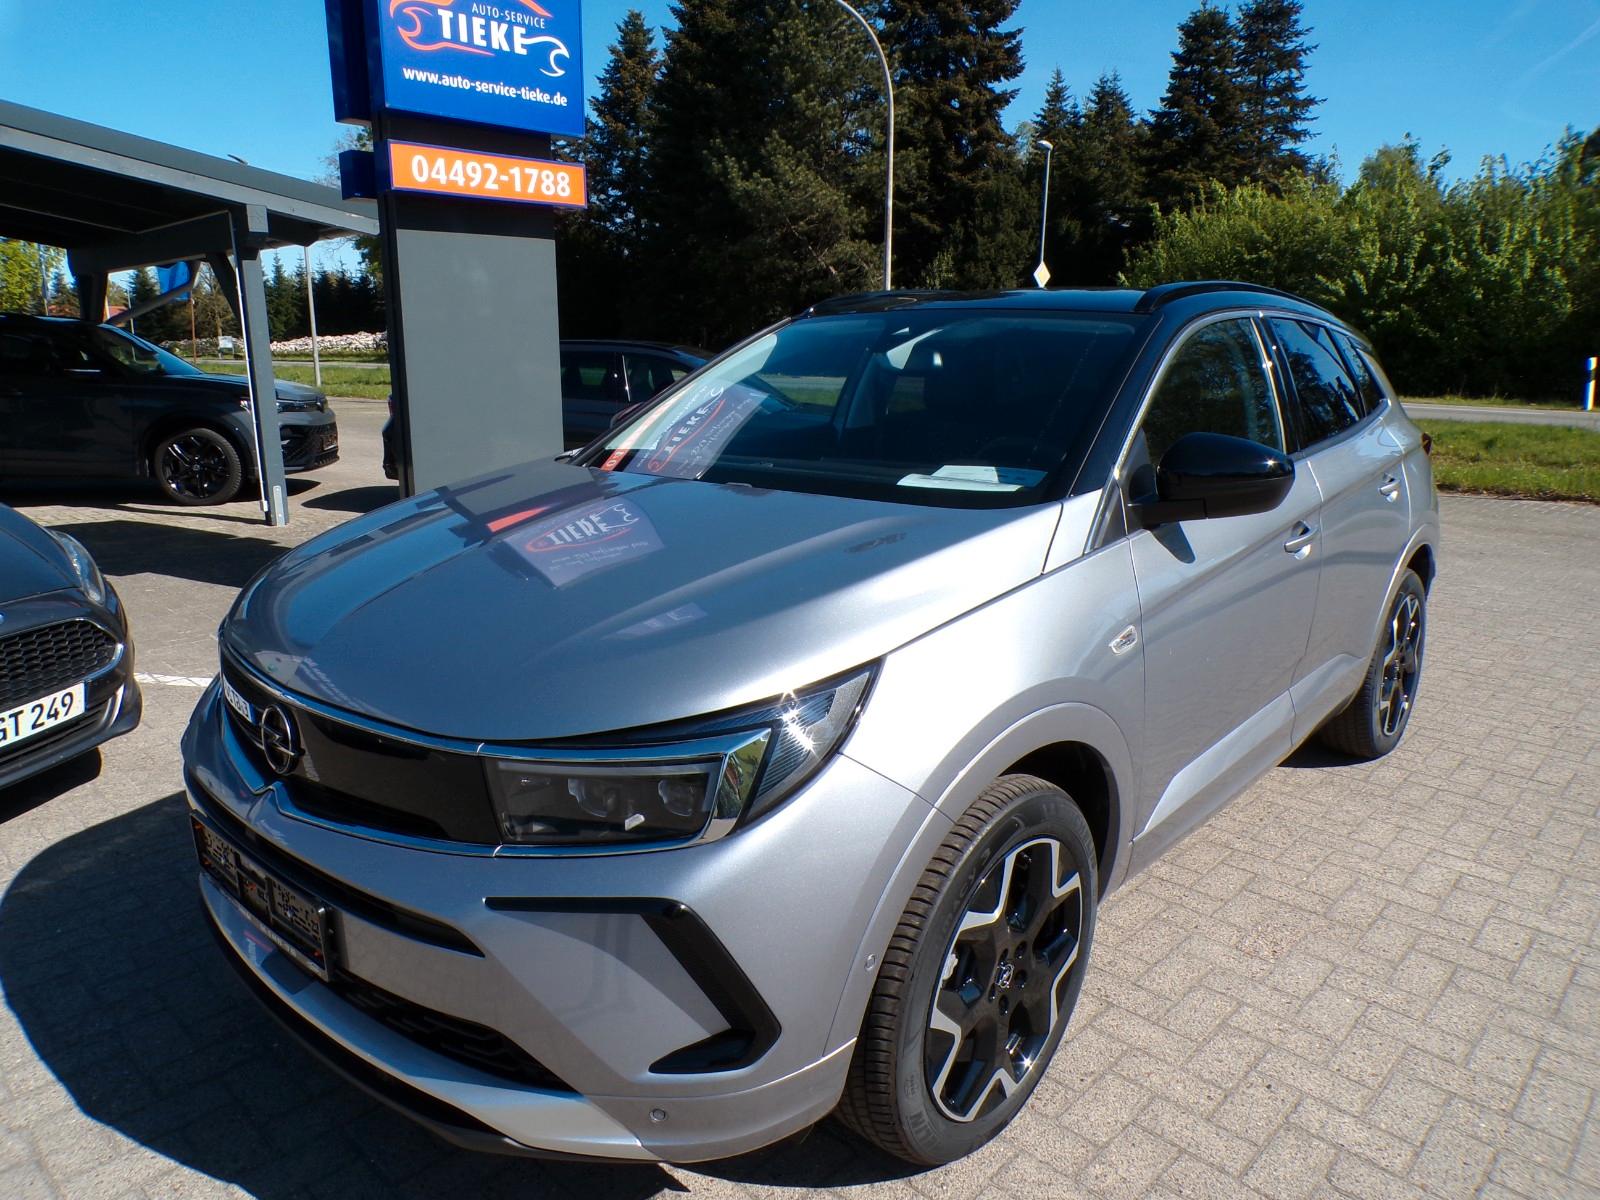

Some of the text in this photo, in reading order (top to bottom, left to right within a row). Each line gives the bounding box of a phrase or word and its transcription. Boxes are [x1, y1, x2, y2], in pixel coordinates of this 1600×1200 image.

[437, 8, 528, 56] TIEKE
[471, 2, 545, 29] AUTO-SERVICE
[402, 67, 568, 107] www.auto-service-tieke.de
[411, 154, 571, 197] 04492-1788
[30, 691, 74, 731] 249
